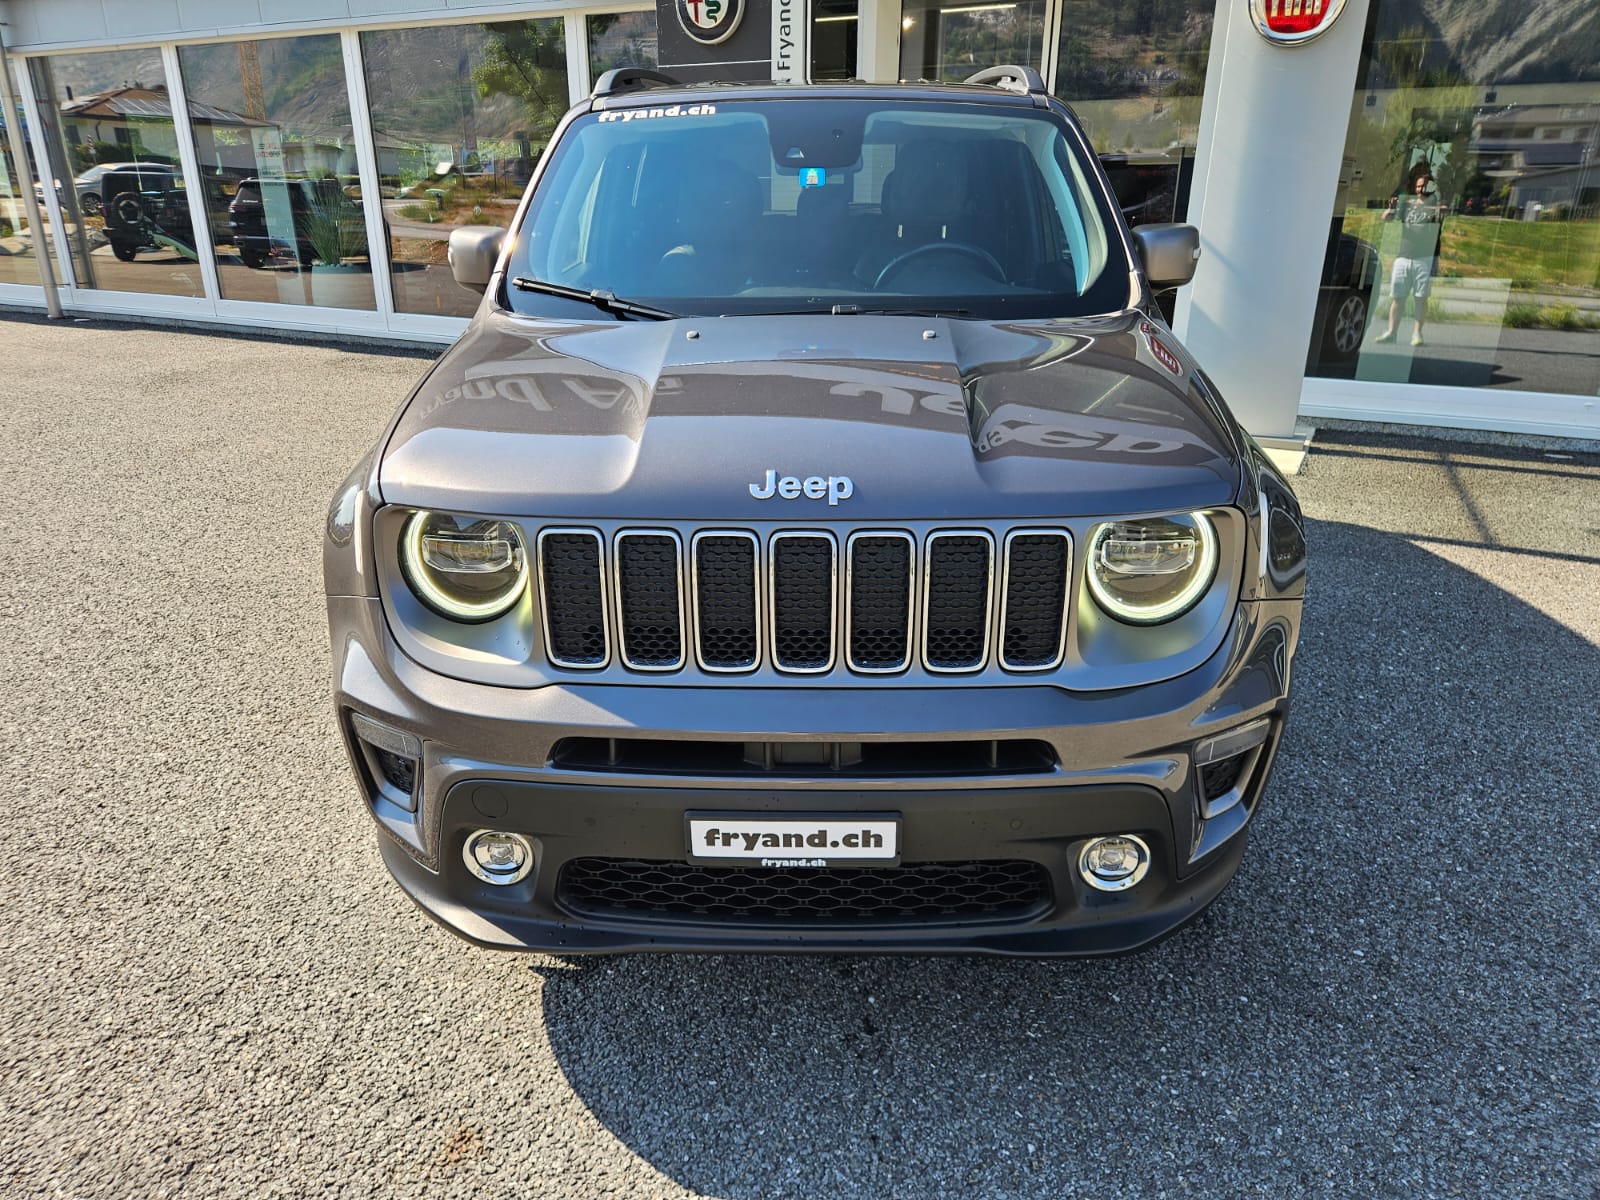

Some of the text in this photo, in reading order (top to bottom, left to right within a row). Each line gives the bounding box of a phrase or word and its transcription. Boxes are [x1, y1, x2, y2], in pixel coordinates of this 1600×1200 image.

[598, 105, 716, 122] fryand.ch
[748, 469, 854, 506] Jeep
[704, 828, 883, 851] fryand.ch
[761, 858, 826, 867] fryand.ch
